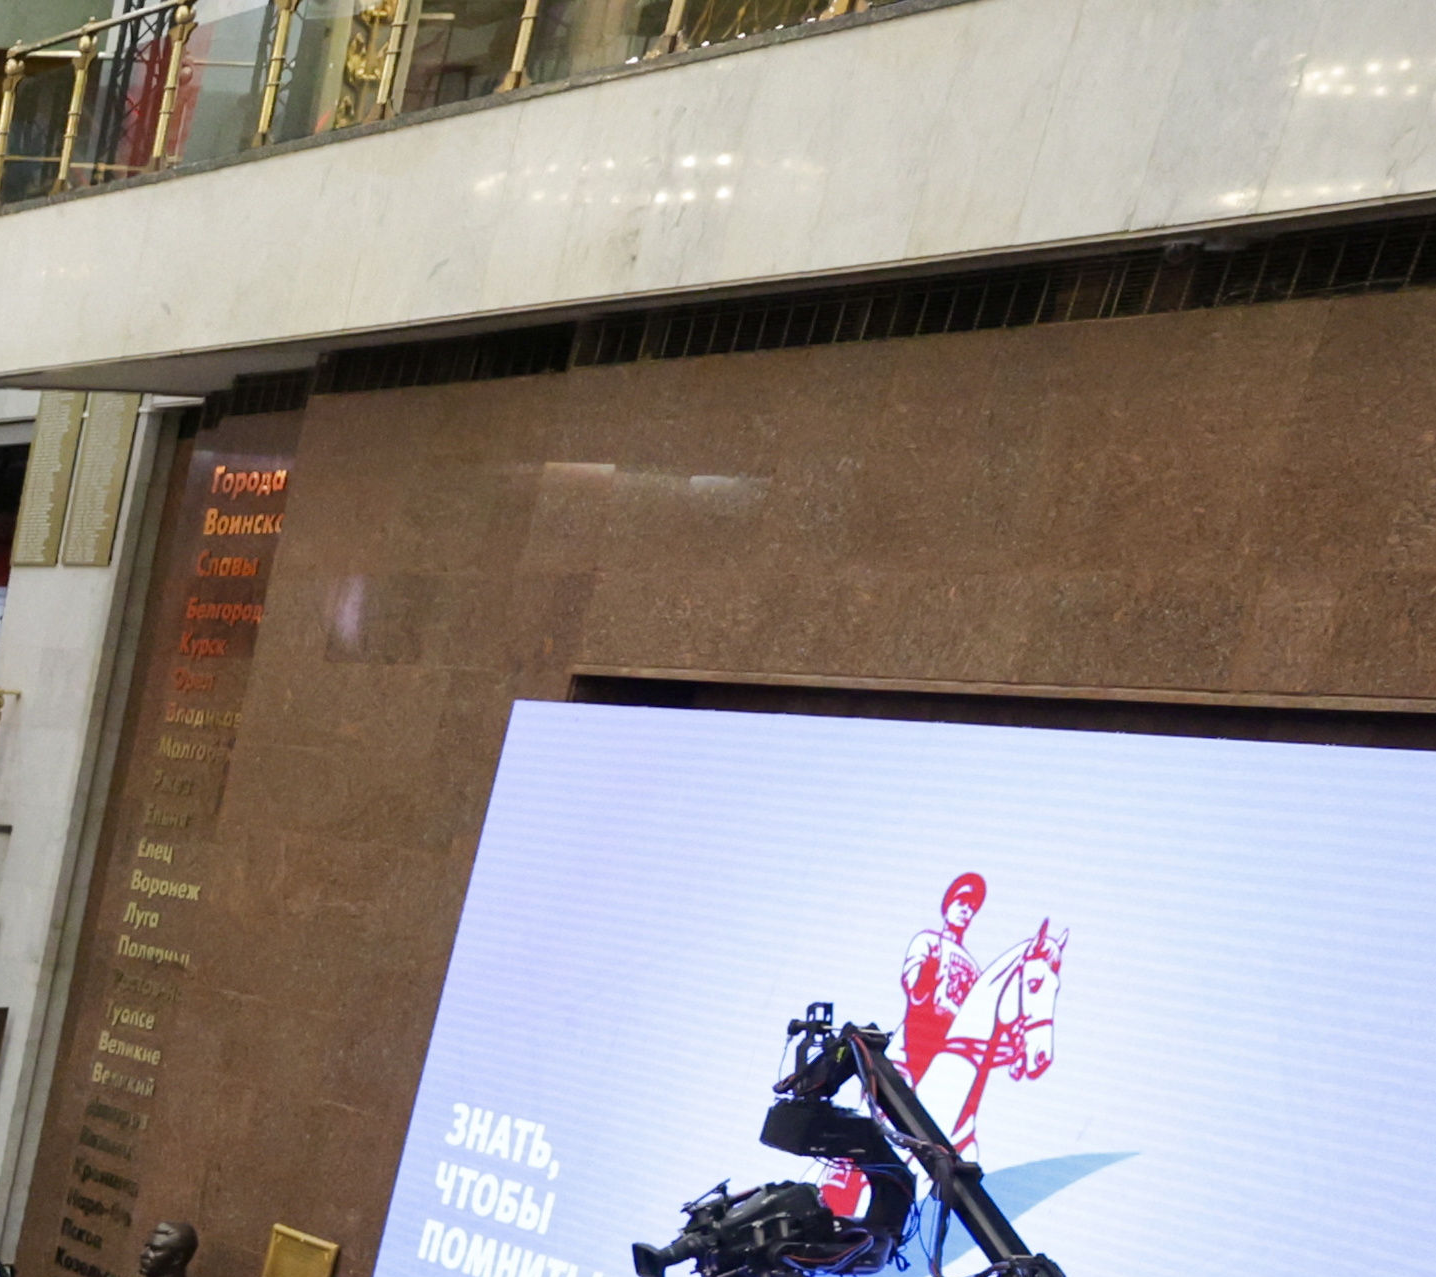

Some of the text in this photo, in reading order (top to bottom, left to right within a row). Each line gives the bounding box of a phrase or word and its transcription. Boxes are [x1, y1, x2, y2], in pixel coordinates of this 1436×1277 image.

[211, 466, 288, 499] Города
[195, 551, 258, 577] Славы
[186, 598, 263, 625] Белгород
[180, 633, 227, 661] Курск
[138, 837, 174, 864] Елец
[131, 869, 201, 901] Воронеж
[123, 902, 160, 930] Луга
[98, 1030, 161, 1066] Великие
[444, 1102, 561, 1181] ЗНАТЬ,
[435, 1161, 554, 1234] ЧТОБЫ
